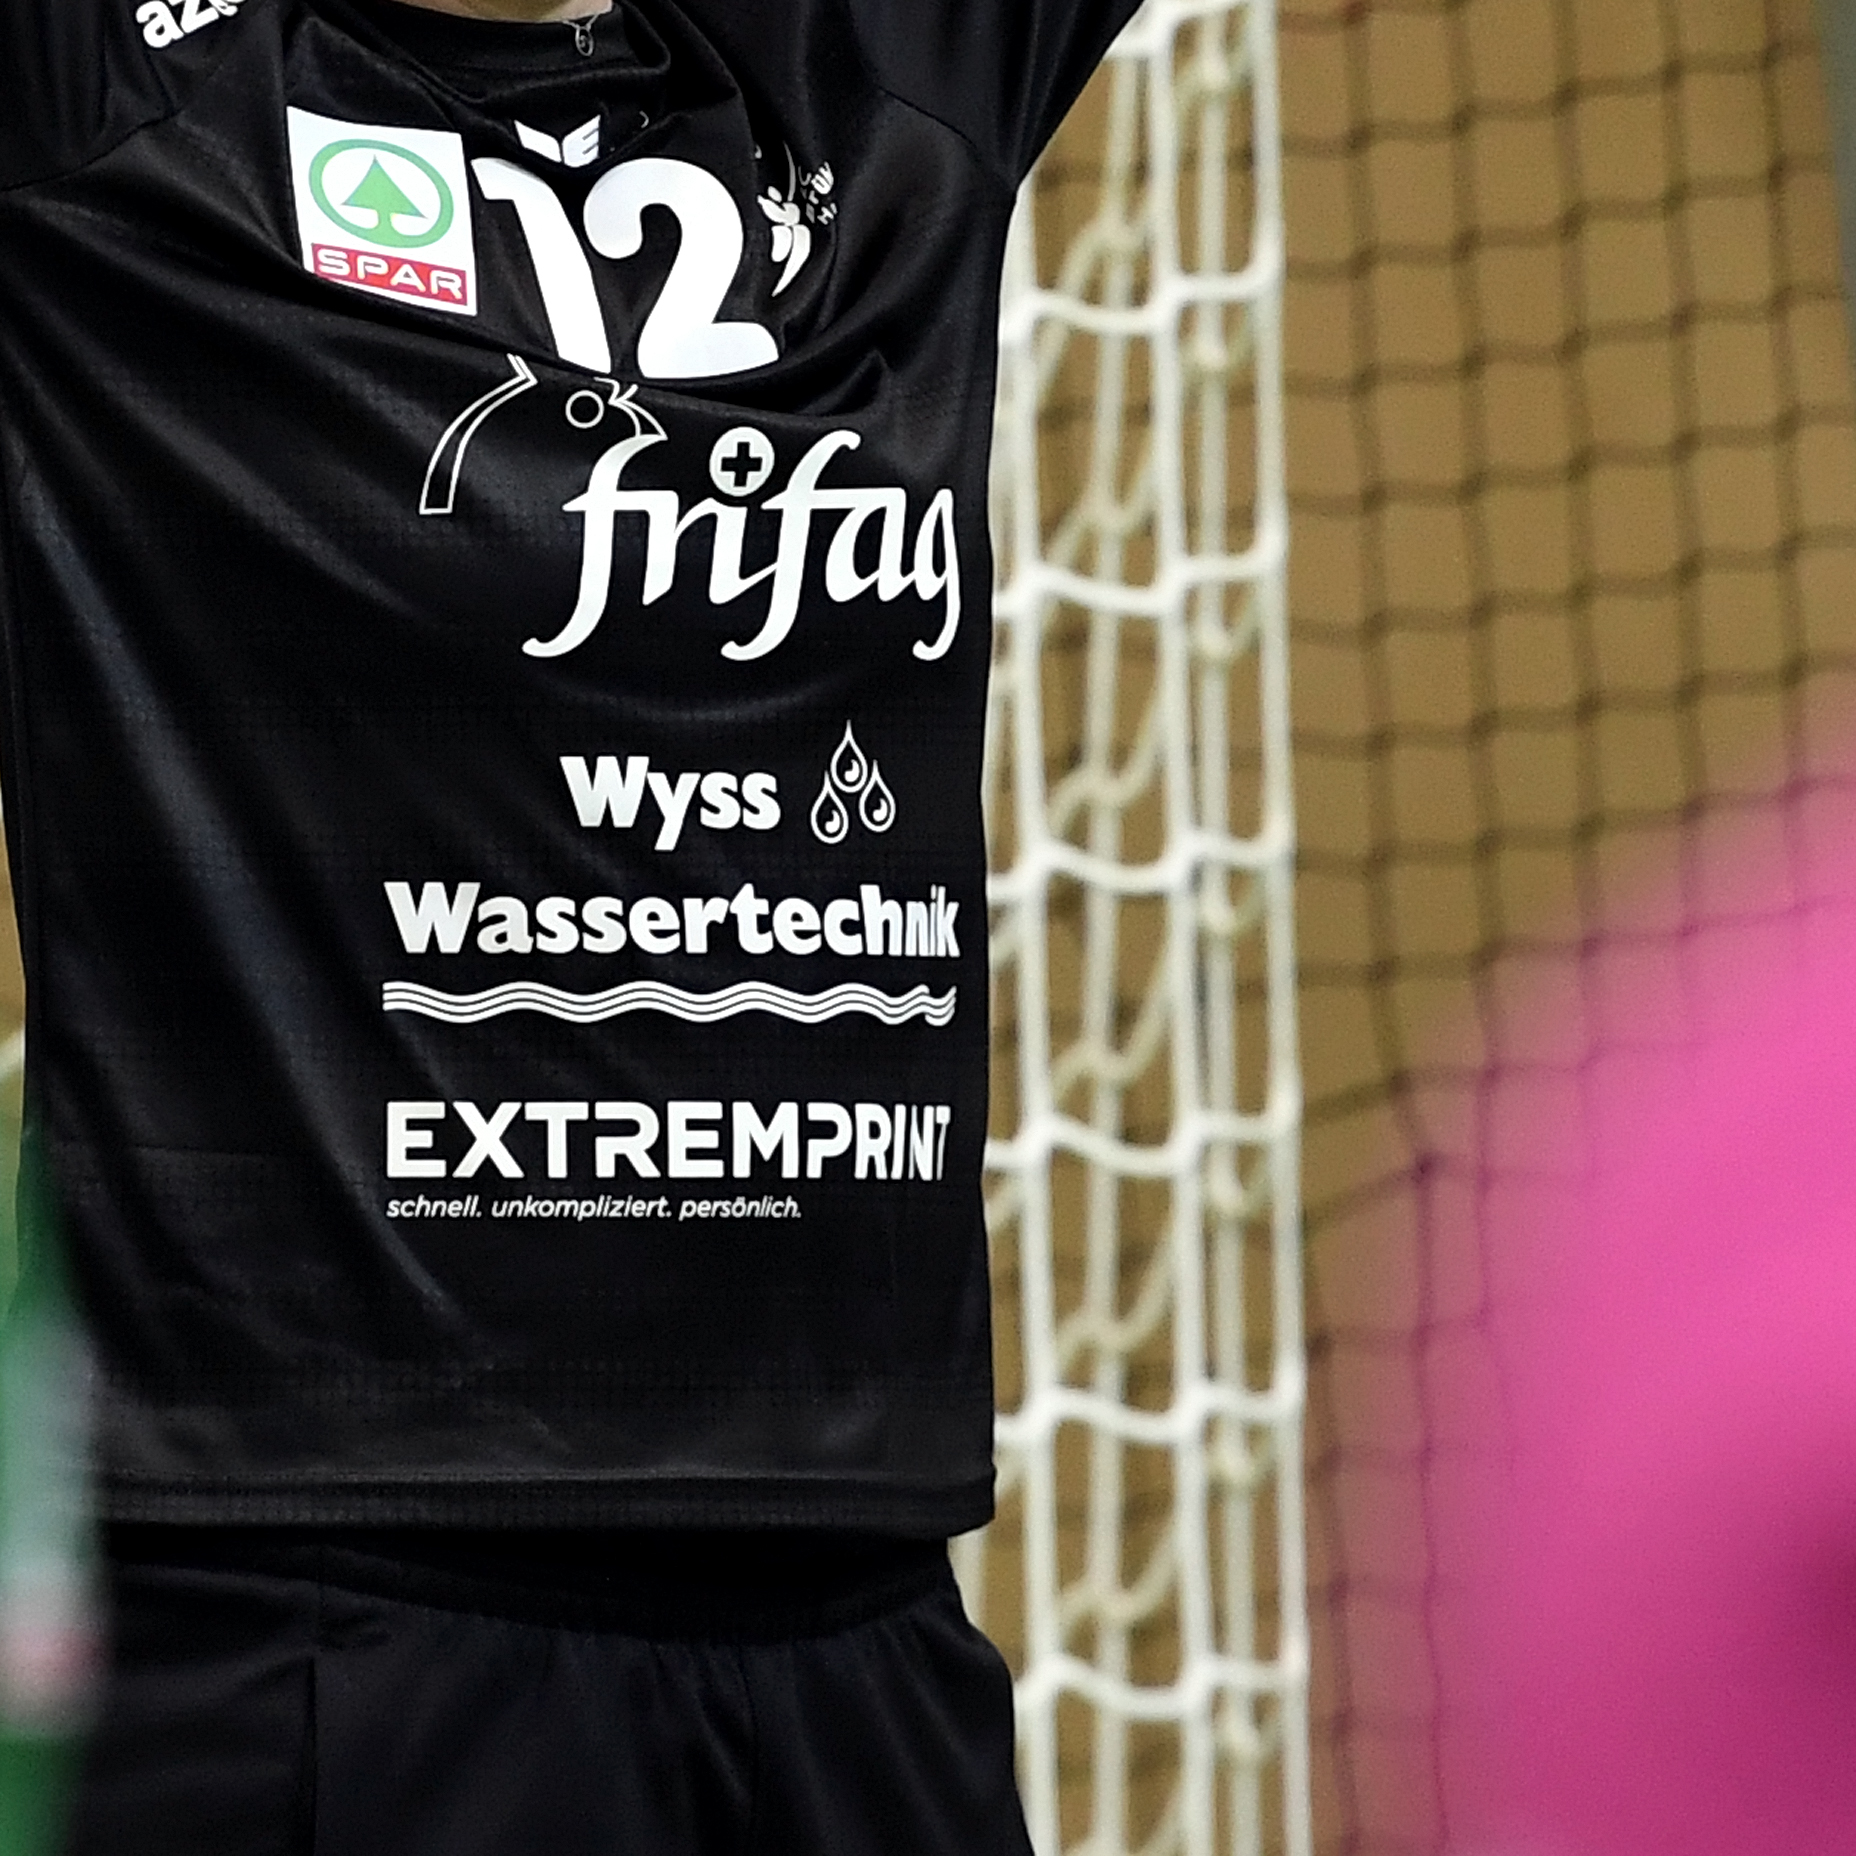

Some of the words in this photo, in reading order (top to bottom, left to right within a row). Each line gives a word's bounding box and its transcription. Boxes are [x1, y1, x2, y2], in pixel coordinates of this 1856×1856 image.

[317, 248, 463, 300] SPAR
[470, 157, 780, 379] 12
[522, 427, 961, 661] frifag
[559, 755, 781, 851] Wyss
[383, 881, 961, 958] Wassertechnik
[386, 1100, 951, 1181] EXTREMPRINT
[386, 1194, 482, 1219] schnell.
[490, 1194, 672, 1223] unkompliziert.
[678, 1195, 802, 1222] persönlich.
